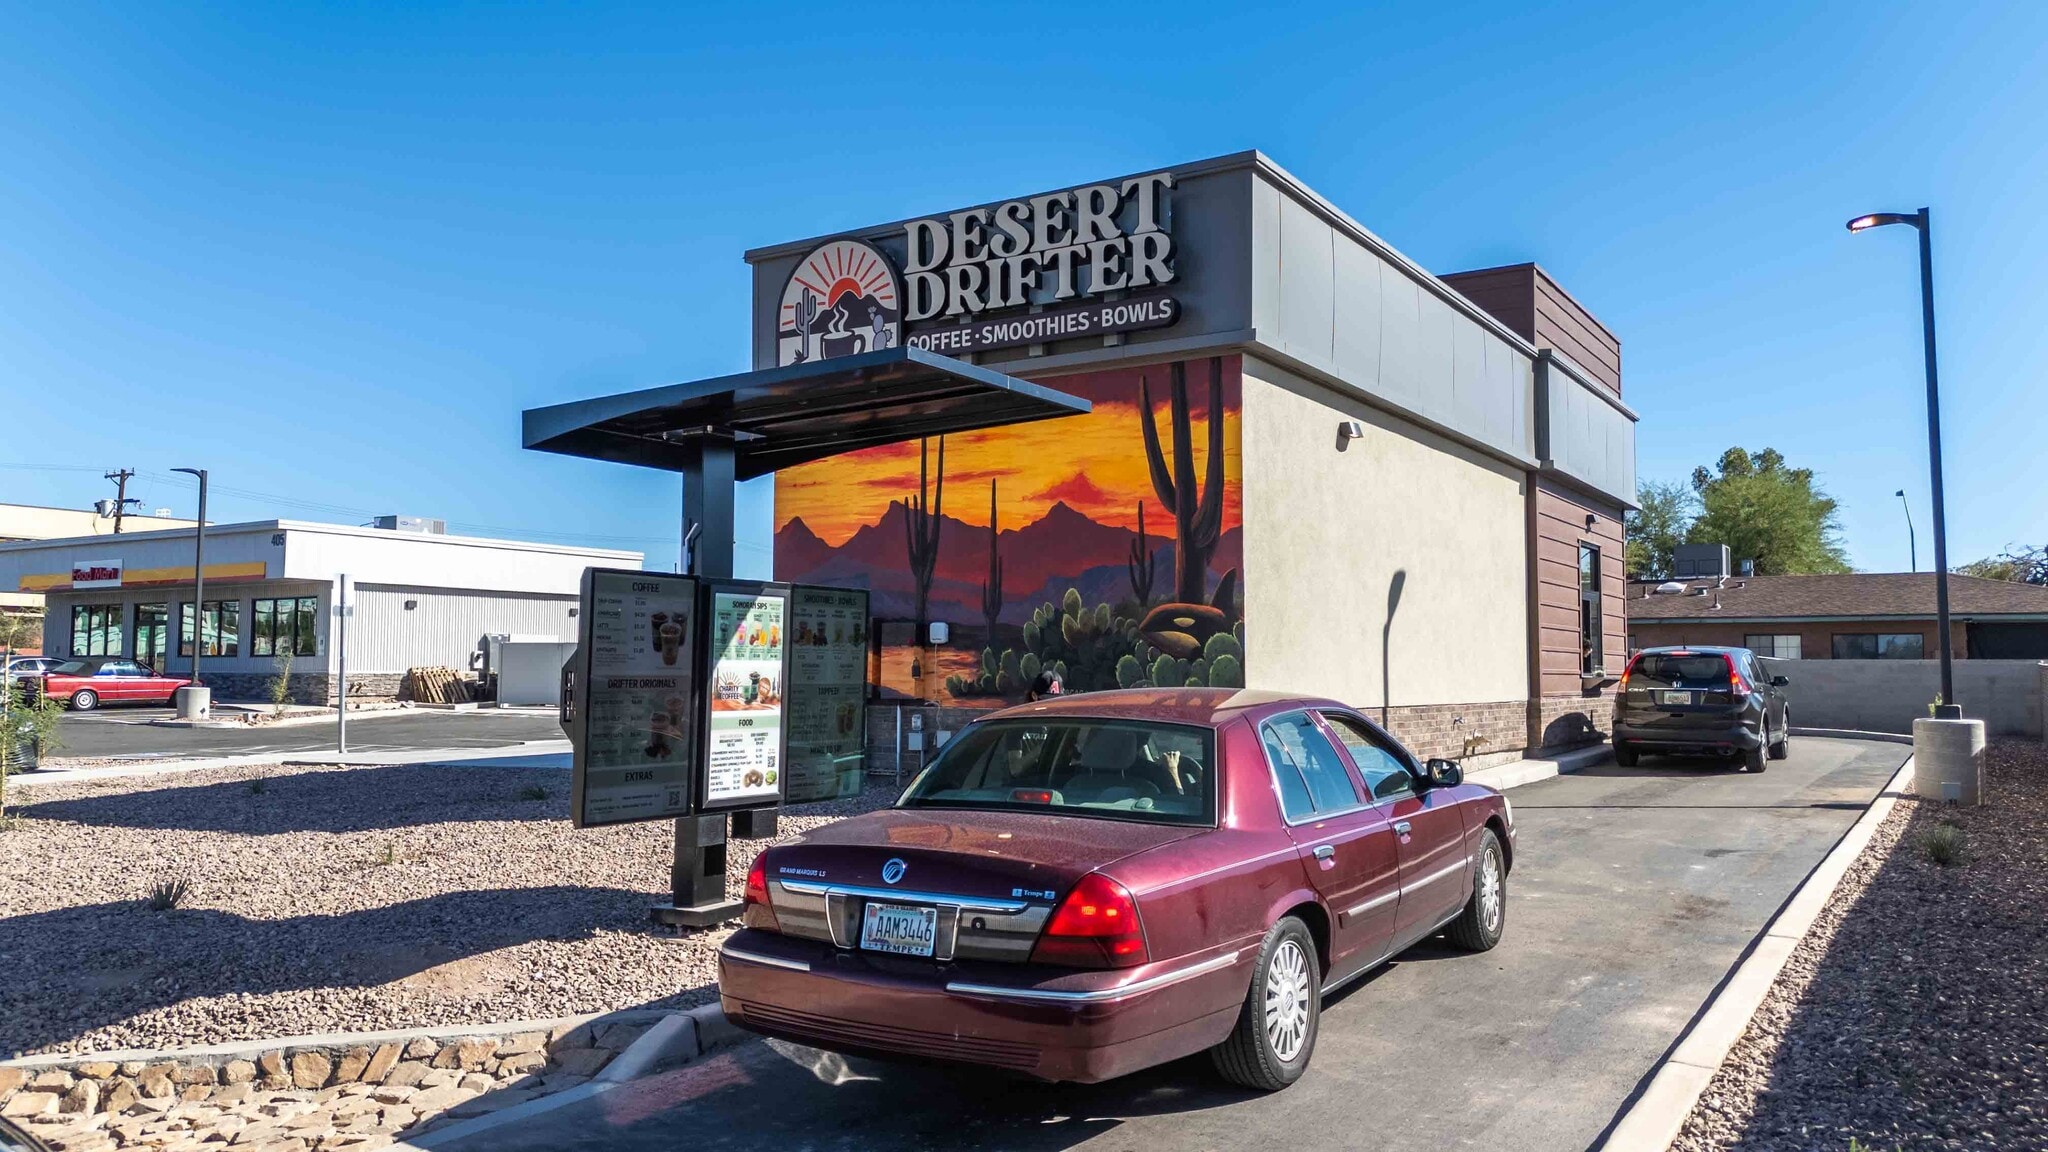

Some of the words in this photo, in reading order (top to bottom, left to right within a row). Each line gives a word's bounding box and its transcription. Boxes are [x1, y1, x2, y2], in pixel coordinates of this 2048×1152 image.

[903, 172, 1173, 275] DESERT
[903, 232, 1175, 321] DRIFTER
[907, 329, 972, 351] COFFEE
[982, 312, 1090, 344] SMOOTHIES
[1101, 299, 1172, 328] BOWLS
[271, 533, 285, 547] 405
[72, 569, 91, 581] Food
[93, 567, 118, 580] Mart
[632, 582, 660, 593] COFFEE
[757, 602, 768, 610] SIPS
[608, 679, 638, 689] DRIFTER
[639, 679, 676, 688] ORIGINALS
[625, 771, 653, 782] EXTRAS
[780, 866, 796, 874] GRAND
[796, 868, 817, 876] MARQUIS
[876, 916, 932, 942] AAM3446
[881, 944, 914, 954] TEMPE
